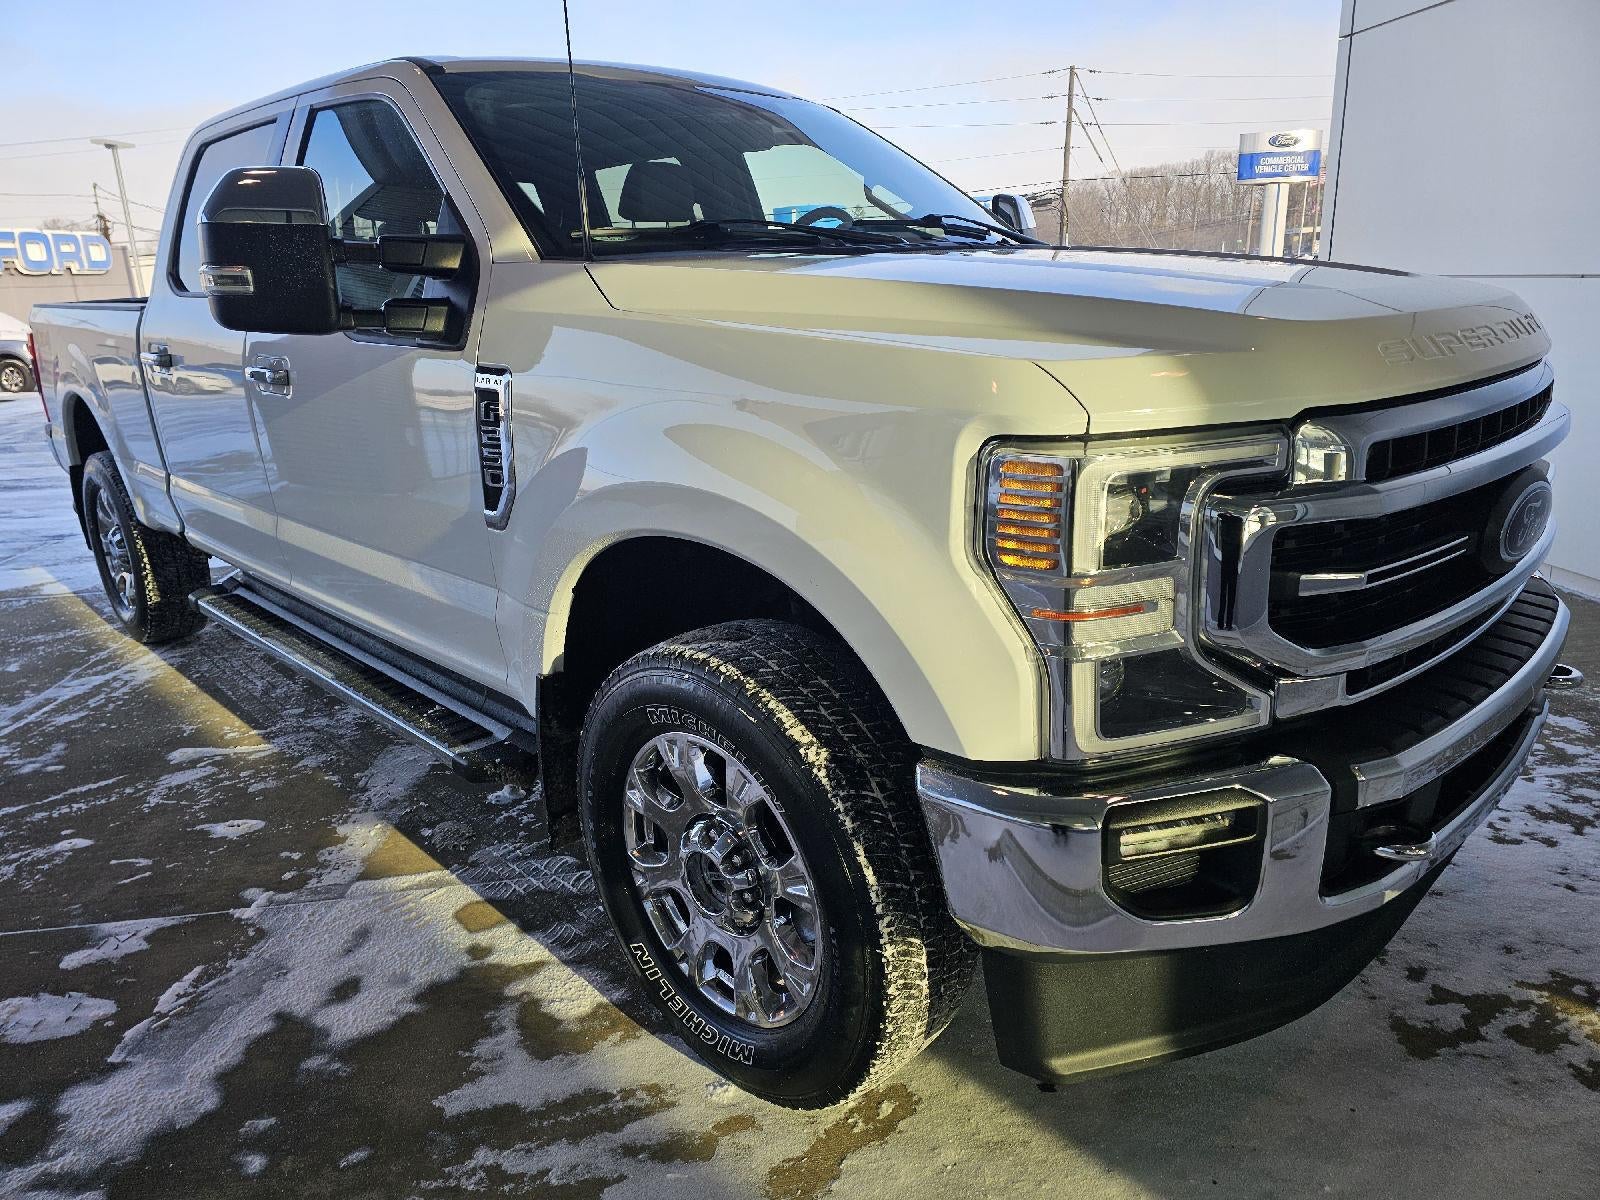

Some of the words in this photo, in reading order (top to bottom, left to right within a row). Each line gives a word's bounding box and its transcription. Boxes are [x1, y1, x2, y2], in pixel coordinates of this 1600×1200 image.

[1274, 134, 1296, 146] Ford
[1261, 156, 1304, 166] COMMERCIAL
[1255, 165, 1282, 173] VEHICLE
[1284, 163, 1309, 172] CENTER
[1377, 325, 1504, 367] SUPER
[476, 376, 503, 386] LARAT
[646, 707, 786, 814] MICHELIN
[630, 942, 756, 1066] MICHELIN
